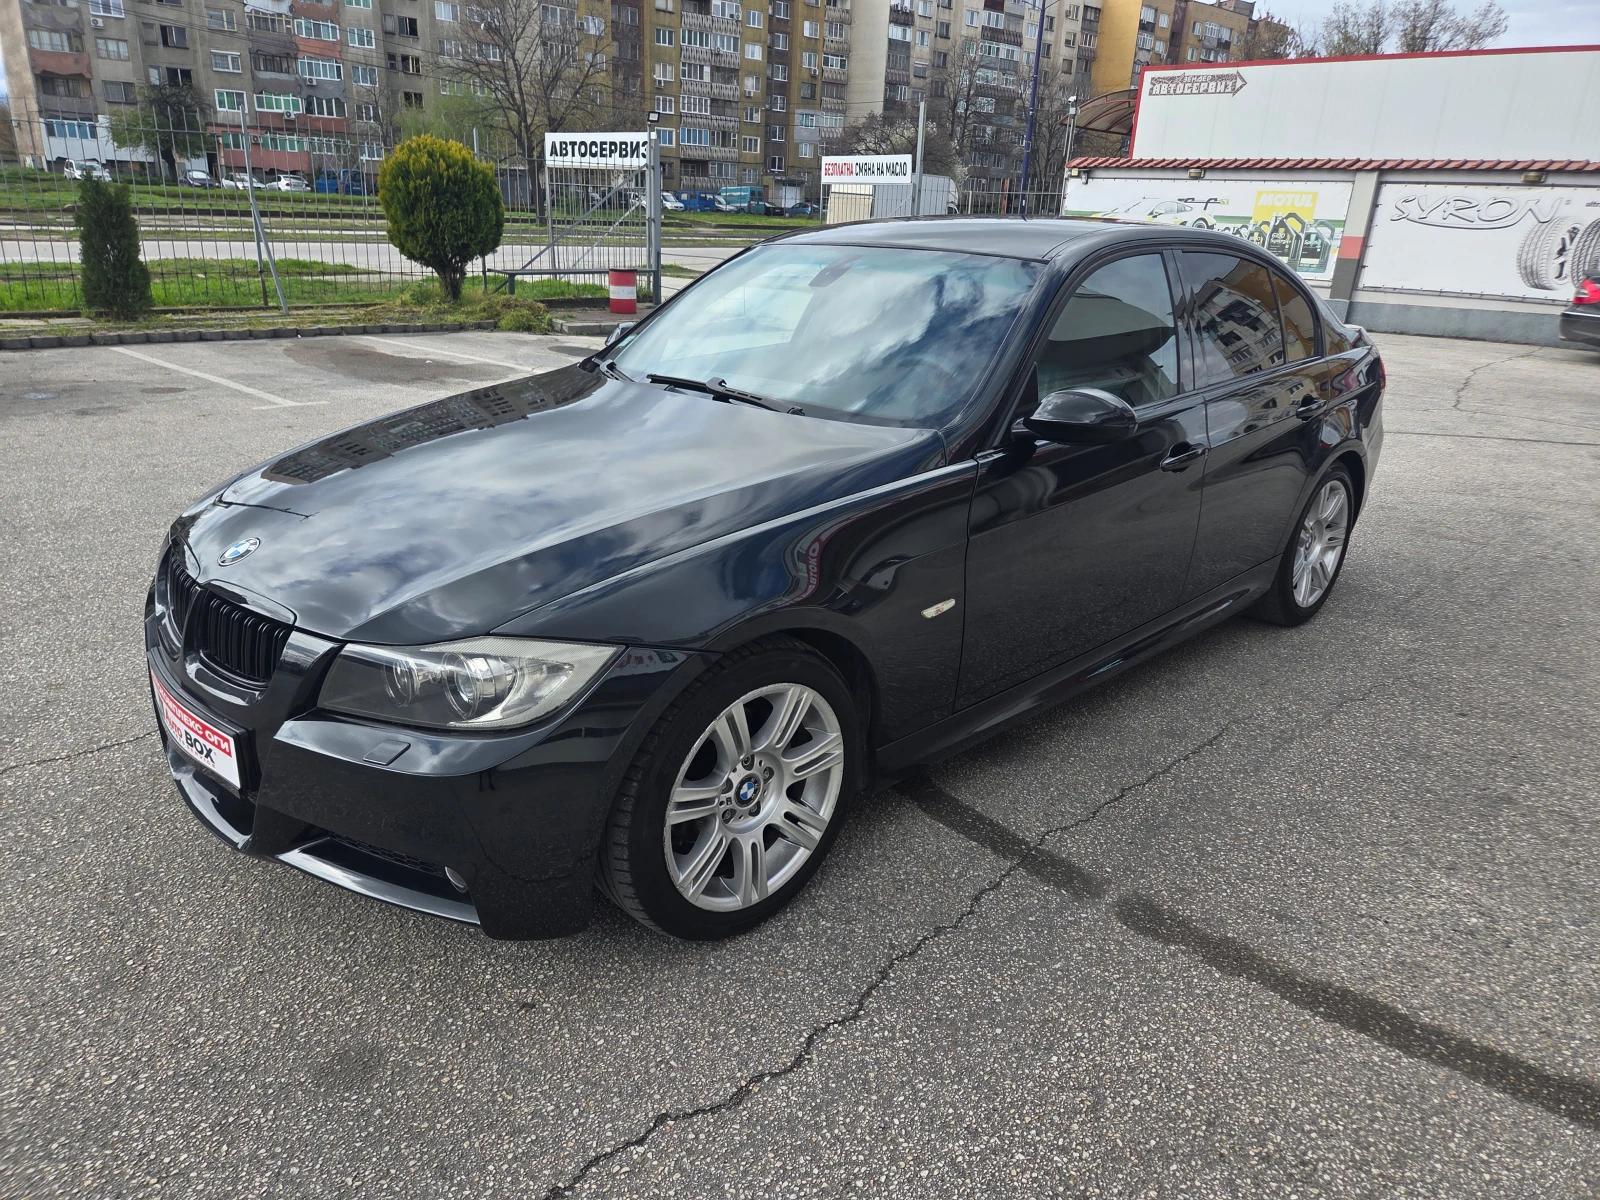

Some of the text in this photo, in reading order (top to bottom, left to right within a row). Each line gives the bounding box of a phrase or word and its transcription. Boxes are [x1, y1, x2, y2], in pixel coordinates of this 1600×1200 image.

[1152, 80, 1233, 95] АВТОСЕРВИЗ
[549, 140, 648, 159] АВТОСЕРВИЗ
[824, 161, 908, 177] БЕЗПЛАТНА СМЯНА НА МАСЛО
[1258, 193, 1314, 208] MOTUL
[1390, 194, 1563, 227] SYRON
[184, 729, 215, 764] BOX
[205, 728, 231, 754] ОГИ
